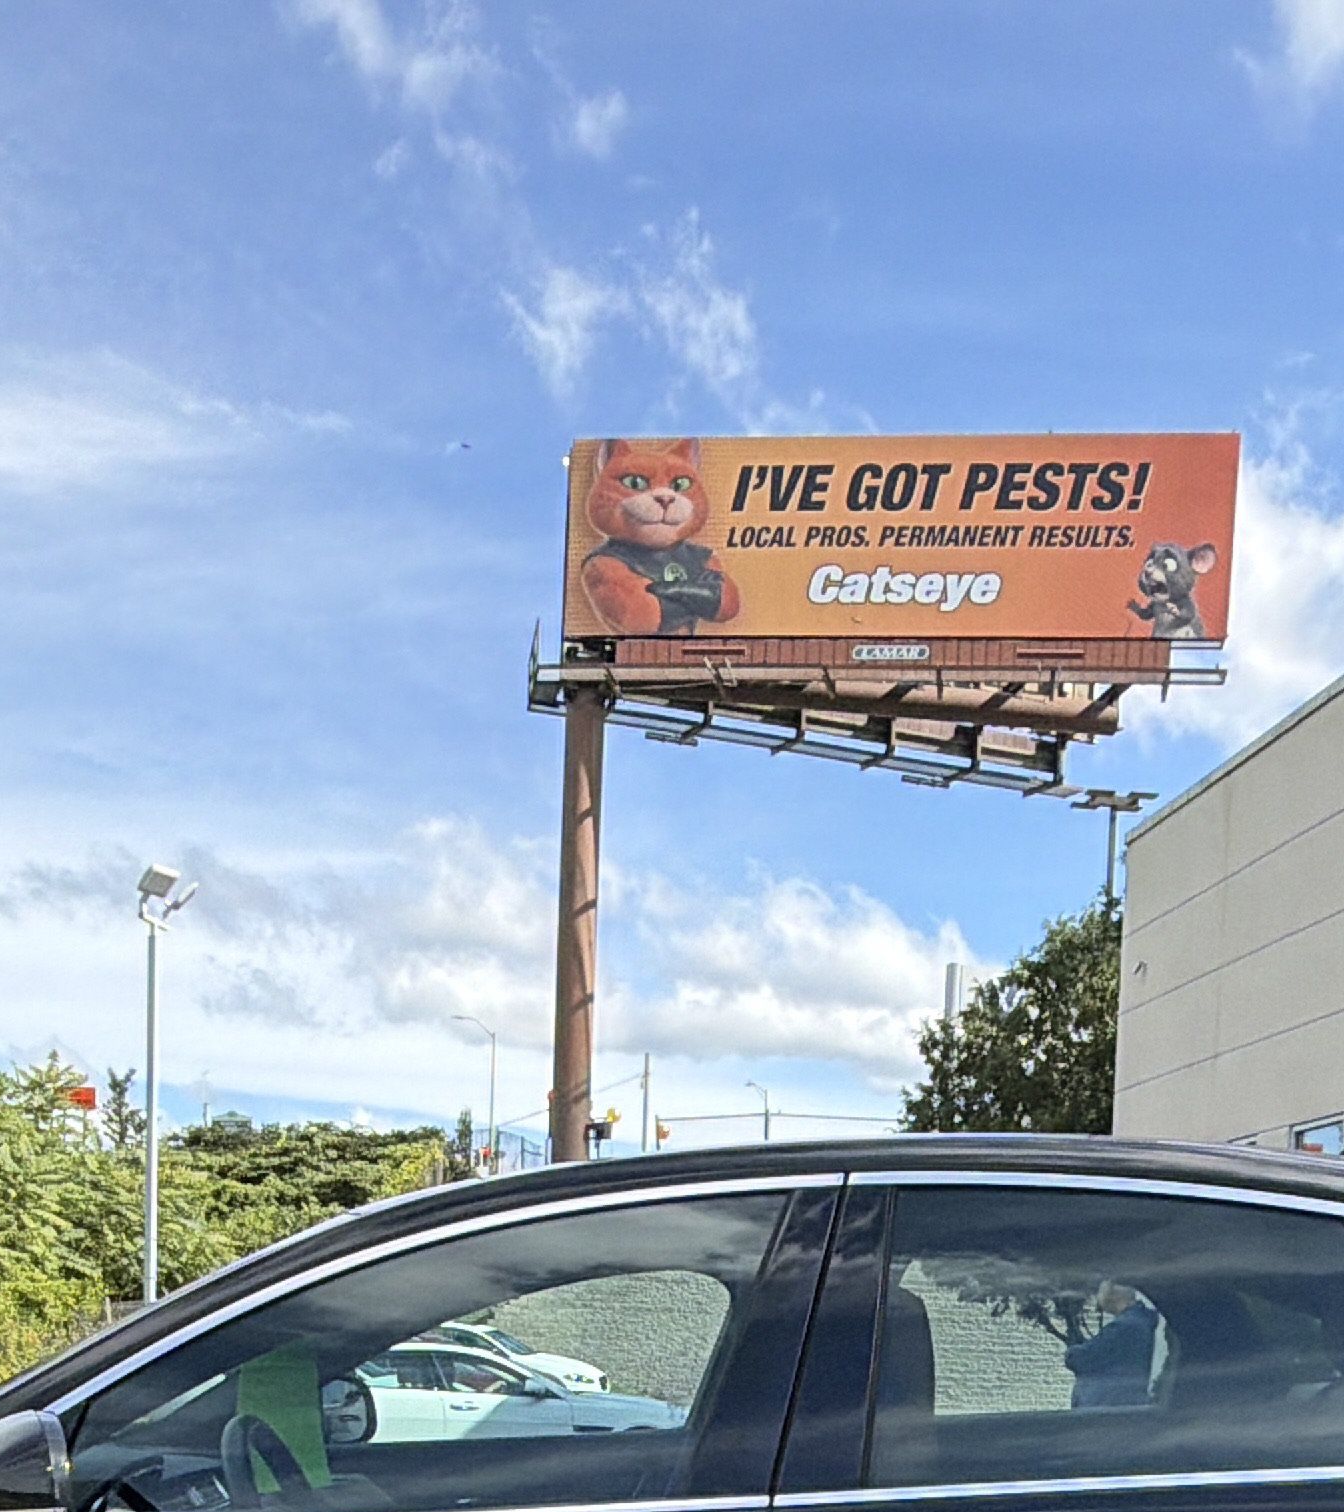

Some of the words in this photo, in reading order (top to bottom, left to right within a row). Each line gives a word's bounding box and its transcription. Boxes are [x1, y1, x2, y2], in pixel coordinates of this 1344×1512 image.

[730, 464, 836, 512] I'VE
[845, 463, 953, 511] GOT
[958, 462, 1153, 511] PESTS!
[726, 526, 798, 548] LOCAL
[803, 526, 870, 548] PROS.
[877, 525, 1025, 548] PERMANENT
[1027, 525, 1136, 548] RESULTS.
[807, 563, 1004, 612] Catseye
